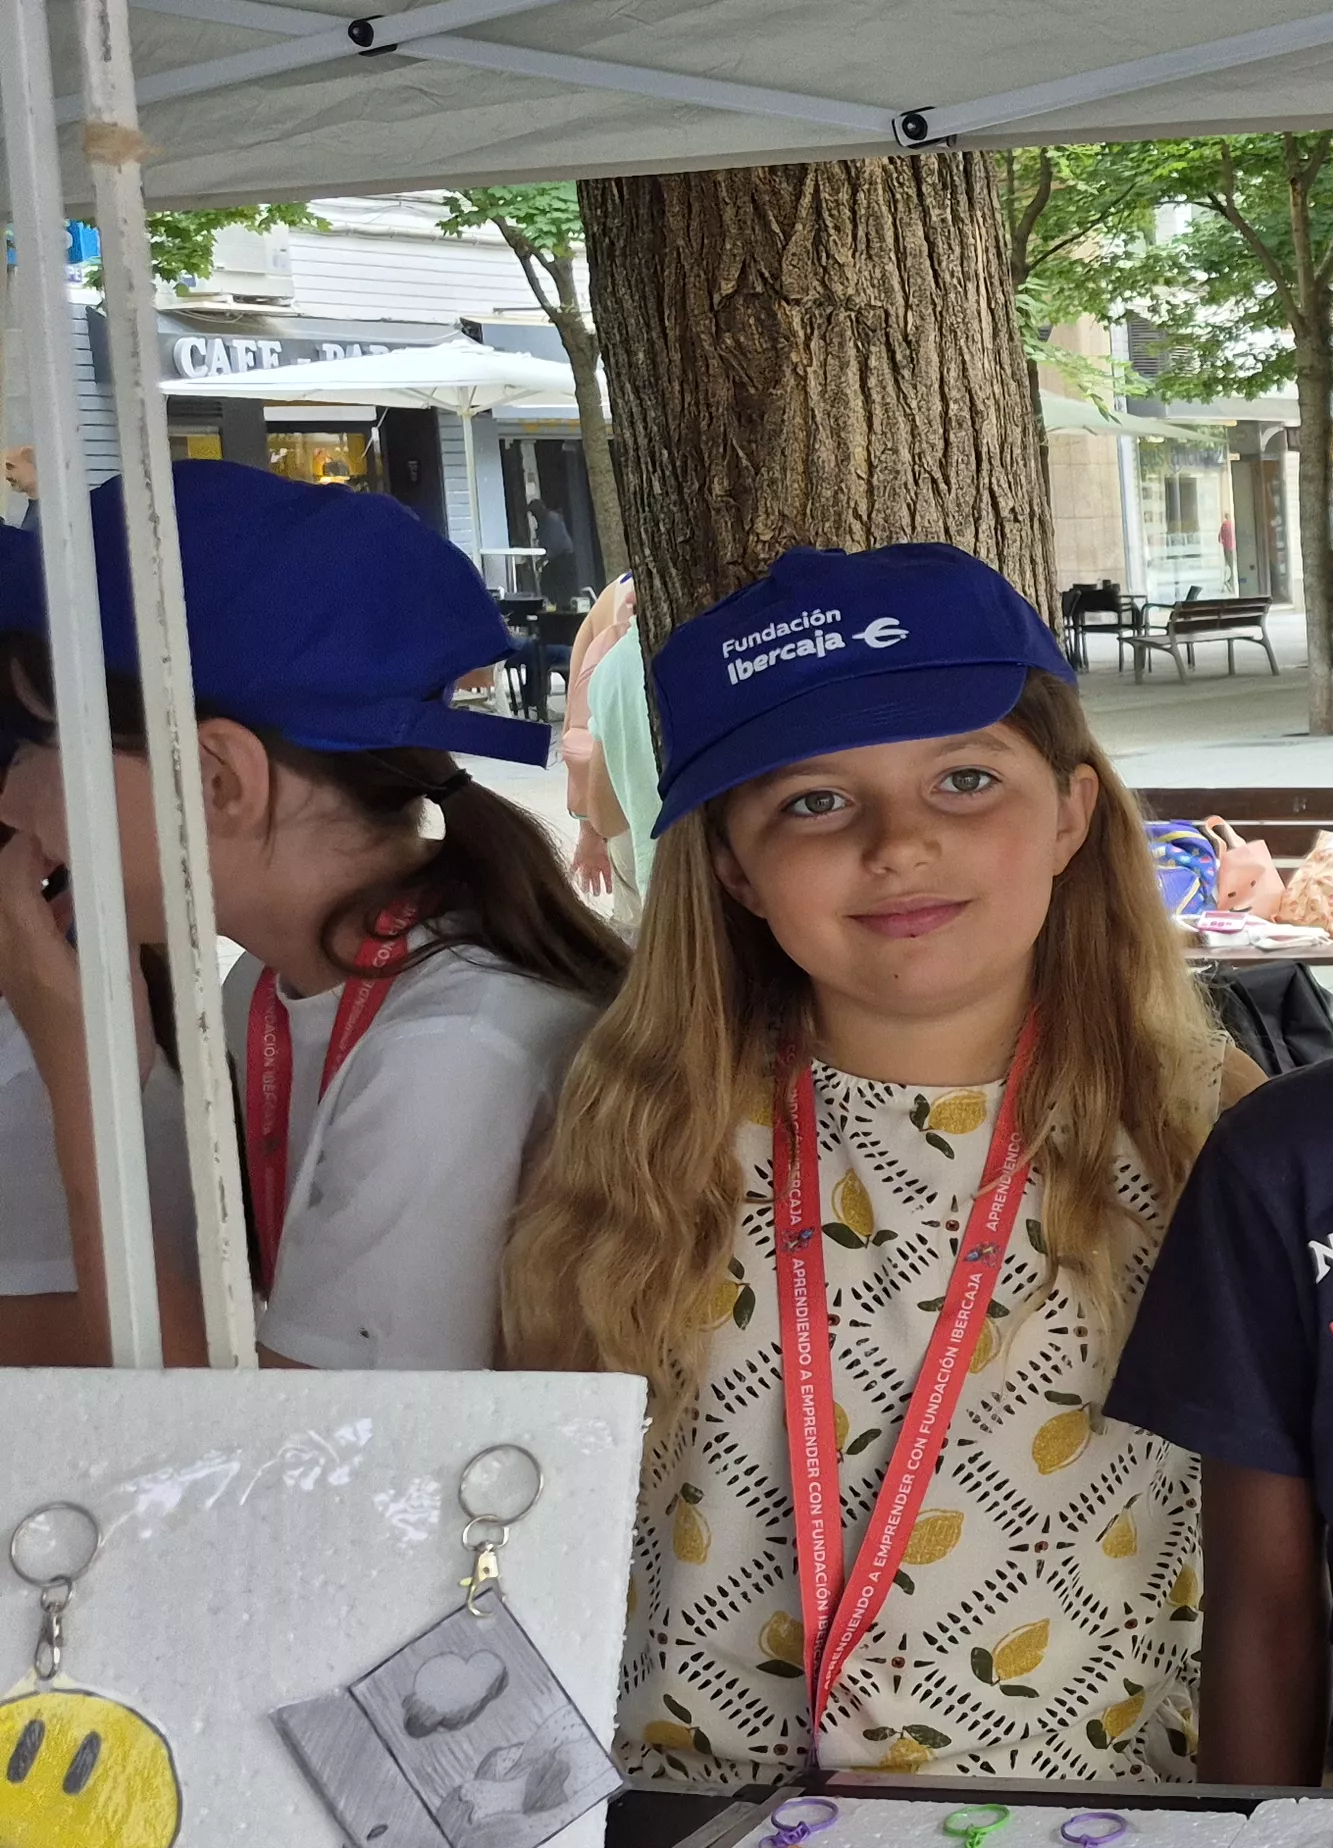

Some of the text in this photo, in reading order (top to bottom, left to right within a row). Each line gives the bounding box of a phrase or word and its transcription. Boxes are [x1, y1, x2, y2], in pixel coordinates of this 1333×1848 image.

[173, 336, 282, 379] CAFE
[722, 608, 842, 658] Fundación
[727, 628, 846, 686] Ibercaja
[985, 1132, 1023, 1232] APRENDIENDO
[792, 1258, 812, 1365] APRENDIENDO
[800, 1370, 812, 1380] A
[800, 1384, 821, 1478] EMPRENDER
[808, 1481, 823, 1516] CON
[822, 1272, 983, 1690] APRENDIENDO A EMPRENDER CON FUNDACIÓN IBERCAJA
[811, 1518, 832, 1610] FUNDACIÓN
